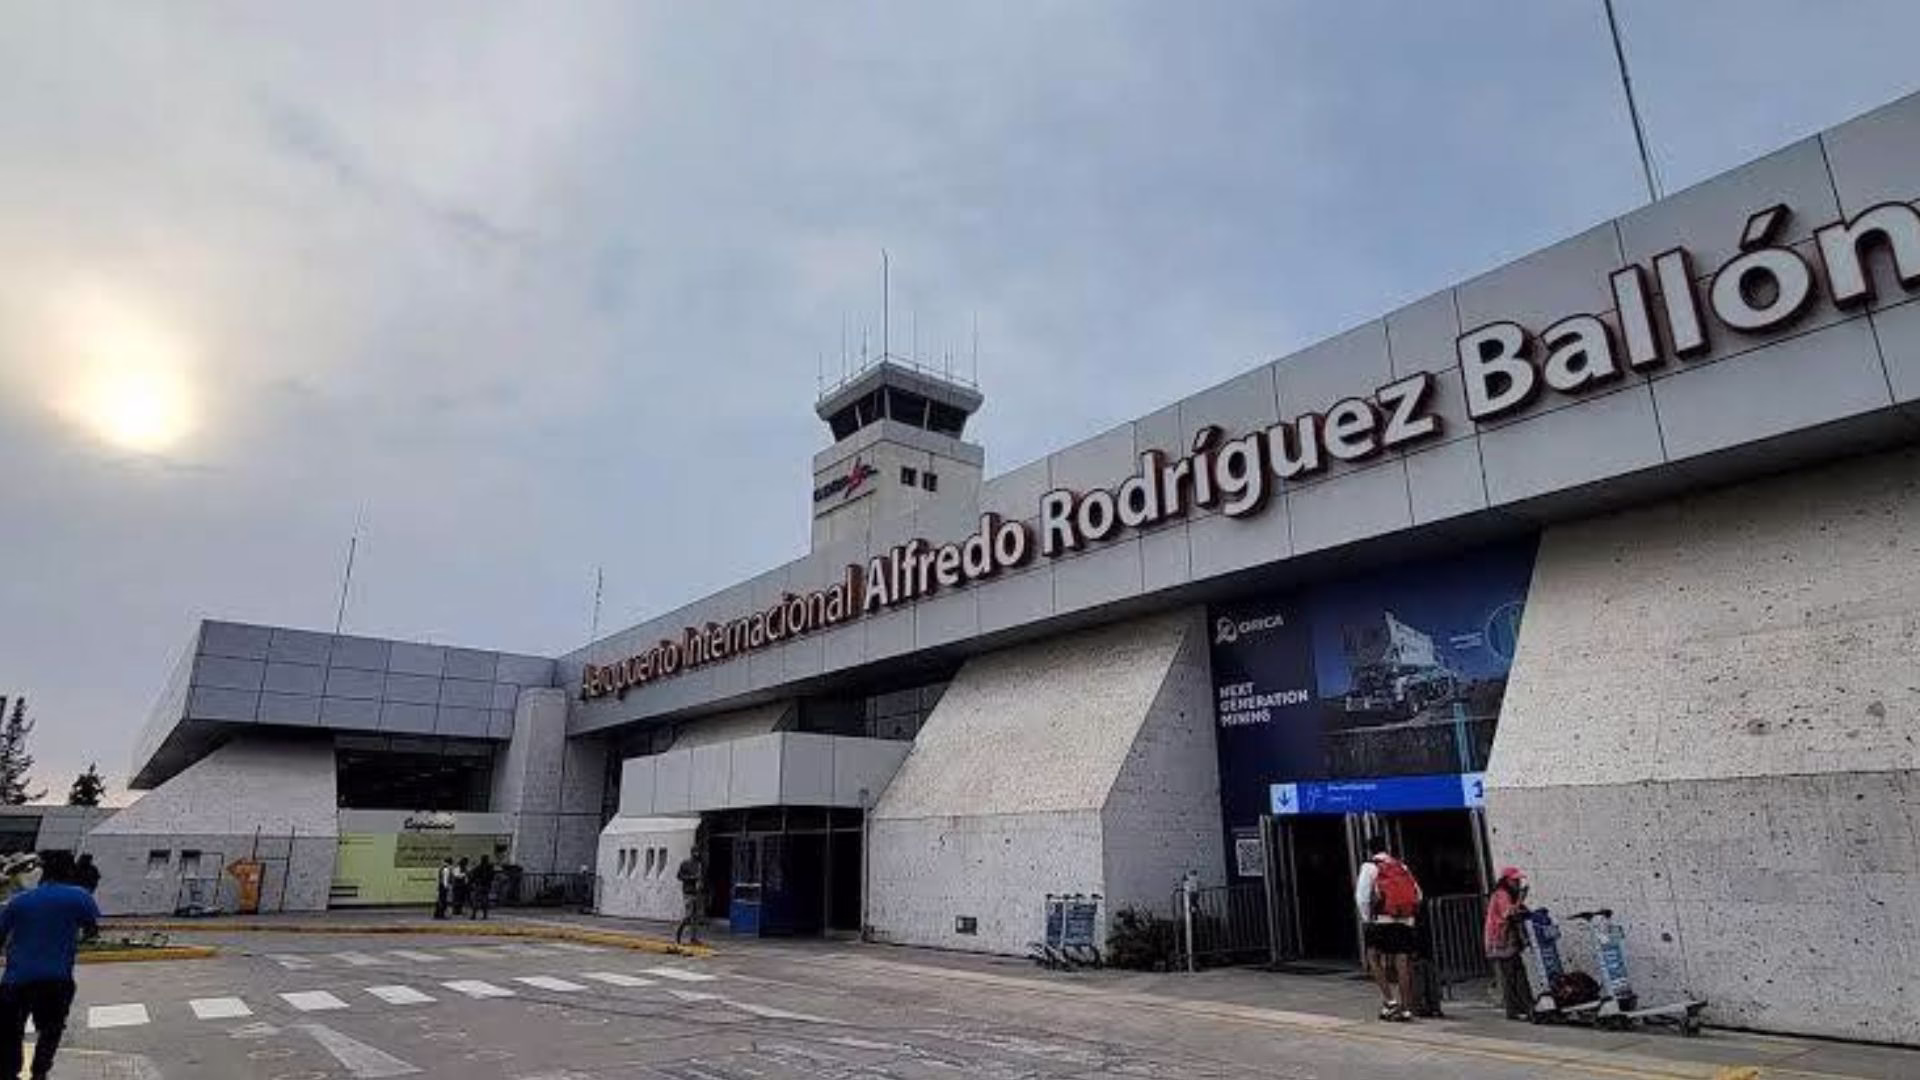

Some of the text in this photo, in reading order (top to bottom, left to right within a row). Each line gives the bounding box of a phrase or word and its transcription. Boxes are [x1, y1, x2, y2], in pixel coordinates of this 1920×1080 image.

[583, 202, 1920, 698] Aeropuerto Internacional Alfredo Rodríguez Ballón
[1239, 615, 1284, 633] ORICA
[1220, 682, 1254, 698] NEXT
[1220, 689, 1308, 712] GENERATION
[1221, 709, 1271, 727] MINING
